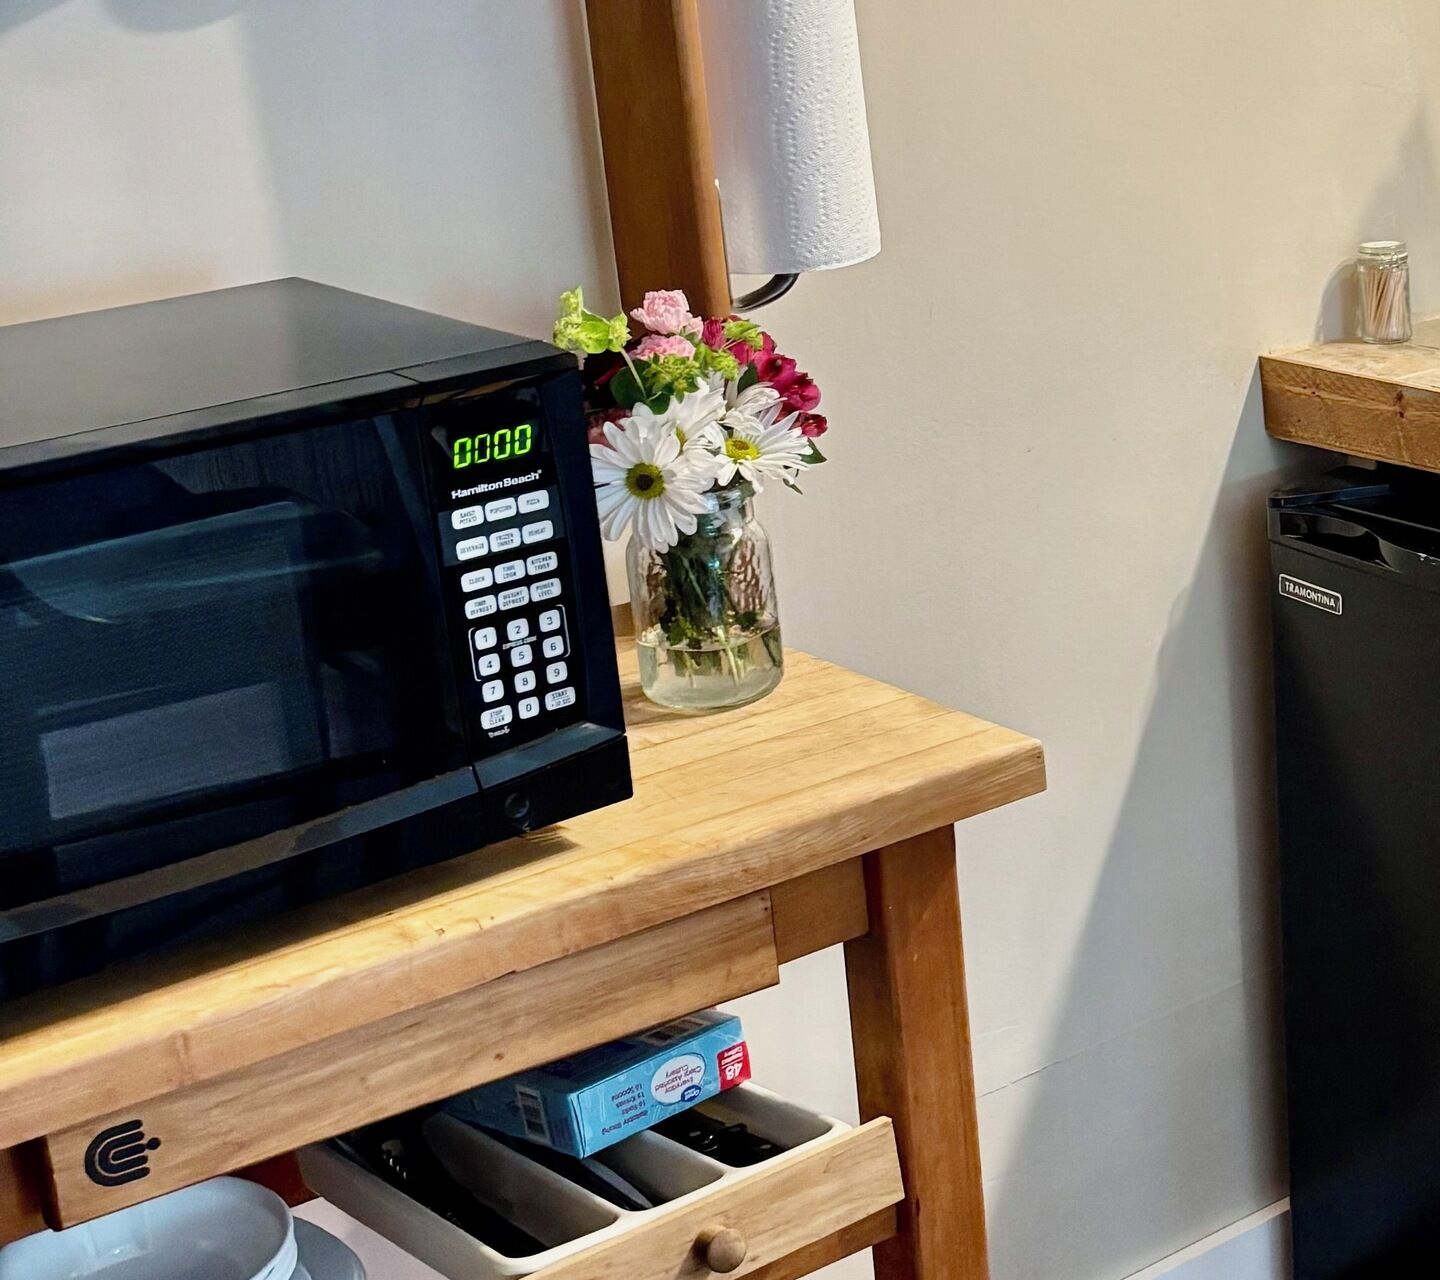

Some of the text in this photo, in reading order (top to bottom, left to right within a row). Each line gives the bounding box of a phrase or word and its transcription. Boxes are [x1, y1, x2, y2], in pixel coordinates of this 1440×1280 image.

[450, 471, 540, 500] Hamilton Beach
[1285, 581, 1336, 608] TRAMONTINA
[547, 616, 553, 626] 3
[515, 625, 521, 634] 2
[550, 642, 557, 651] 6
[519, 651, 525, 660] 5
[486, 660, 493, 669] 4
[554, 668, 560, 677] 9
[522, 677, 529, 686] 8
[490, 686, 496, 695] 7
[525, 703, 532, 712] 0
[725, 1062, 743, 1081] 48
